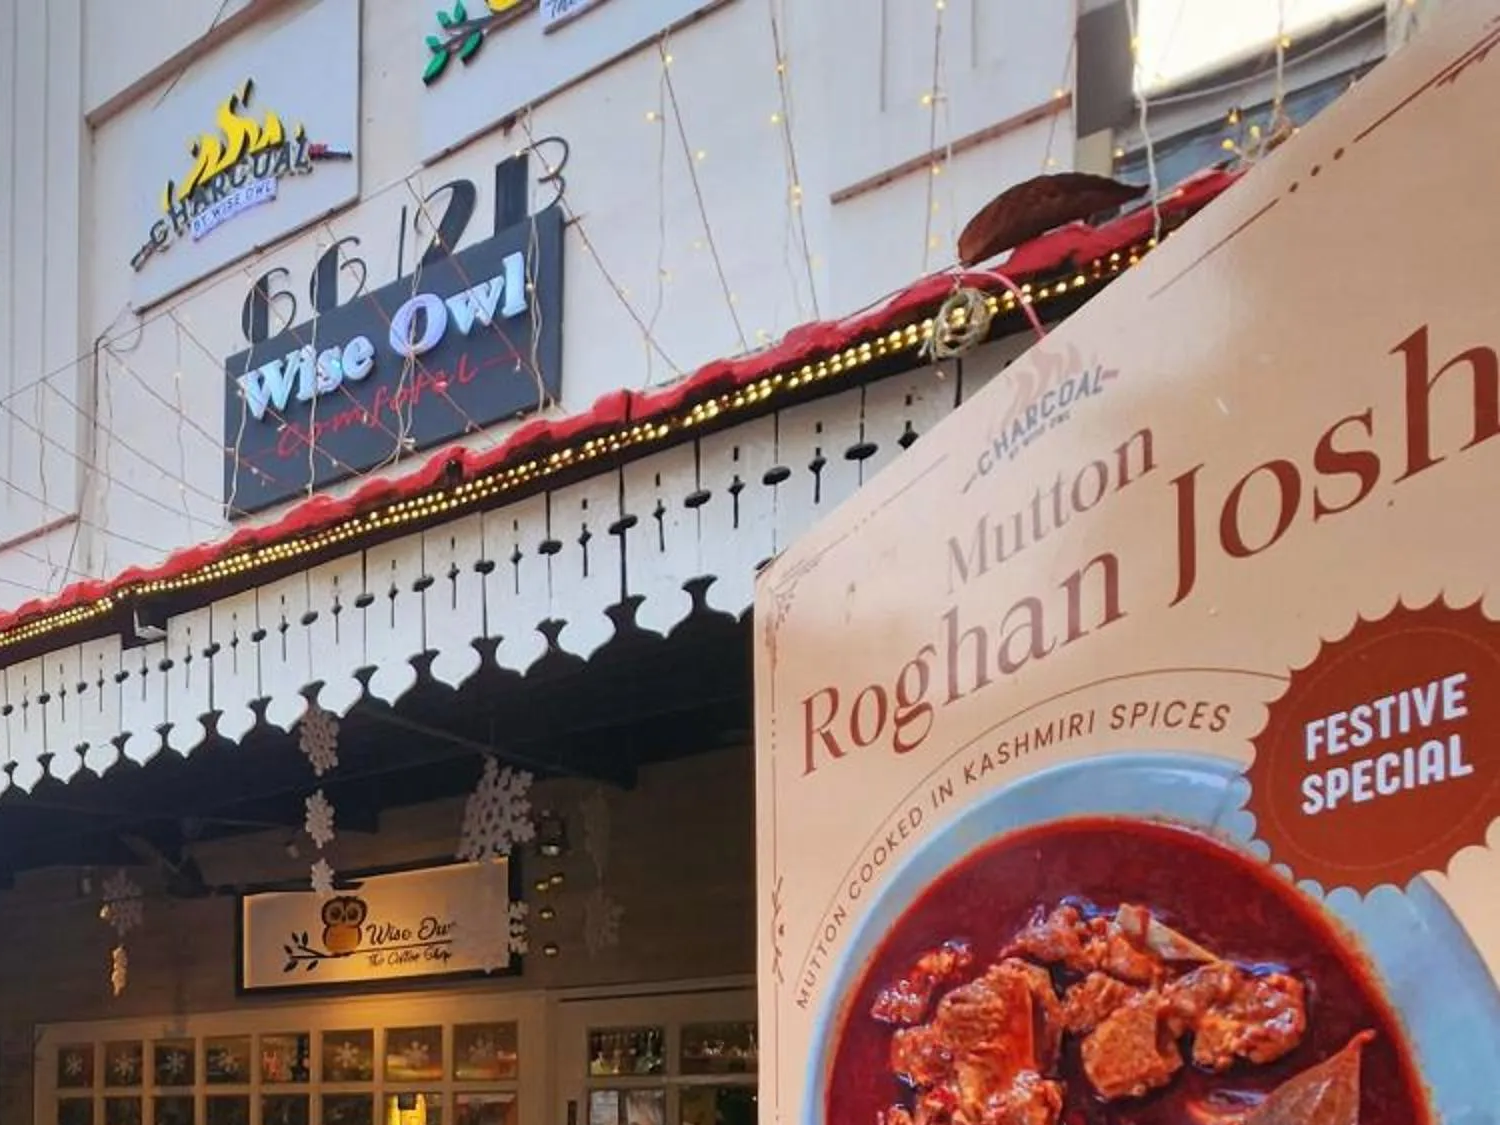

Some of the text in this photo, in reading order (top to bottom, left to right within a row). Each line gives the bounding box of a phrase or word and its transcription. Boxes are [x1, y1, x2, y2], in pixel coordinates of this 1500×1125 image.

[213, 192, 241, 221] WISE
[245, 182, 271, 200] OWL
[237, 252, 529, 420] Wise Owl
[978, 365, 1104, 478] CHARCOAL
[800, 323, 1500, 778] Roghan Josh
[946, 427, 1159, 597] Mutton
[1304, 672, 1469, 762] FESTIVE
[1301, 738, 1473, 816] SPECIAL
[796, 700, 1232, 1010] MUTTON COOKED IN KASHMIRI SPICES
[366, 922, 413, 945] Wise
